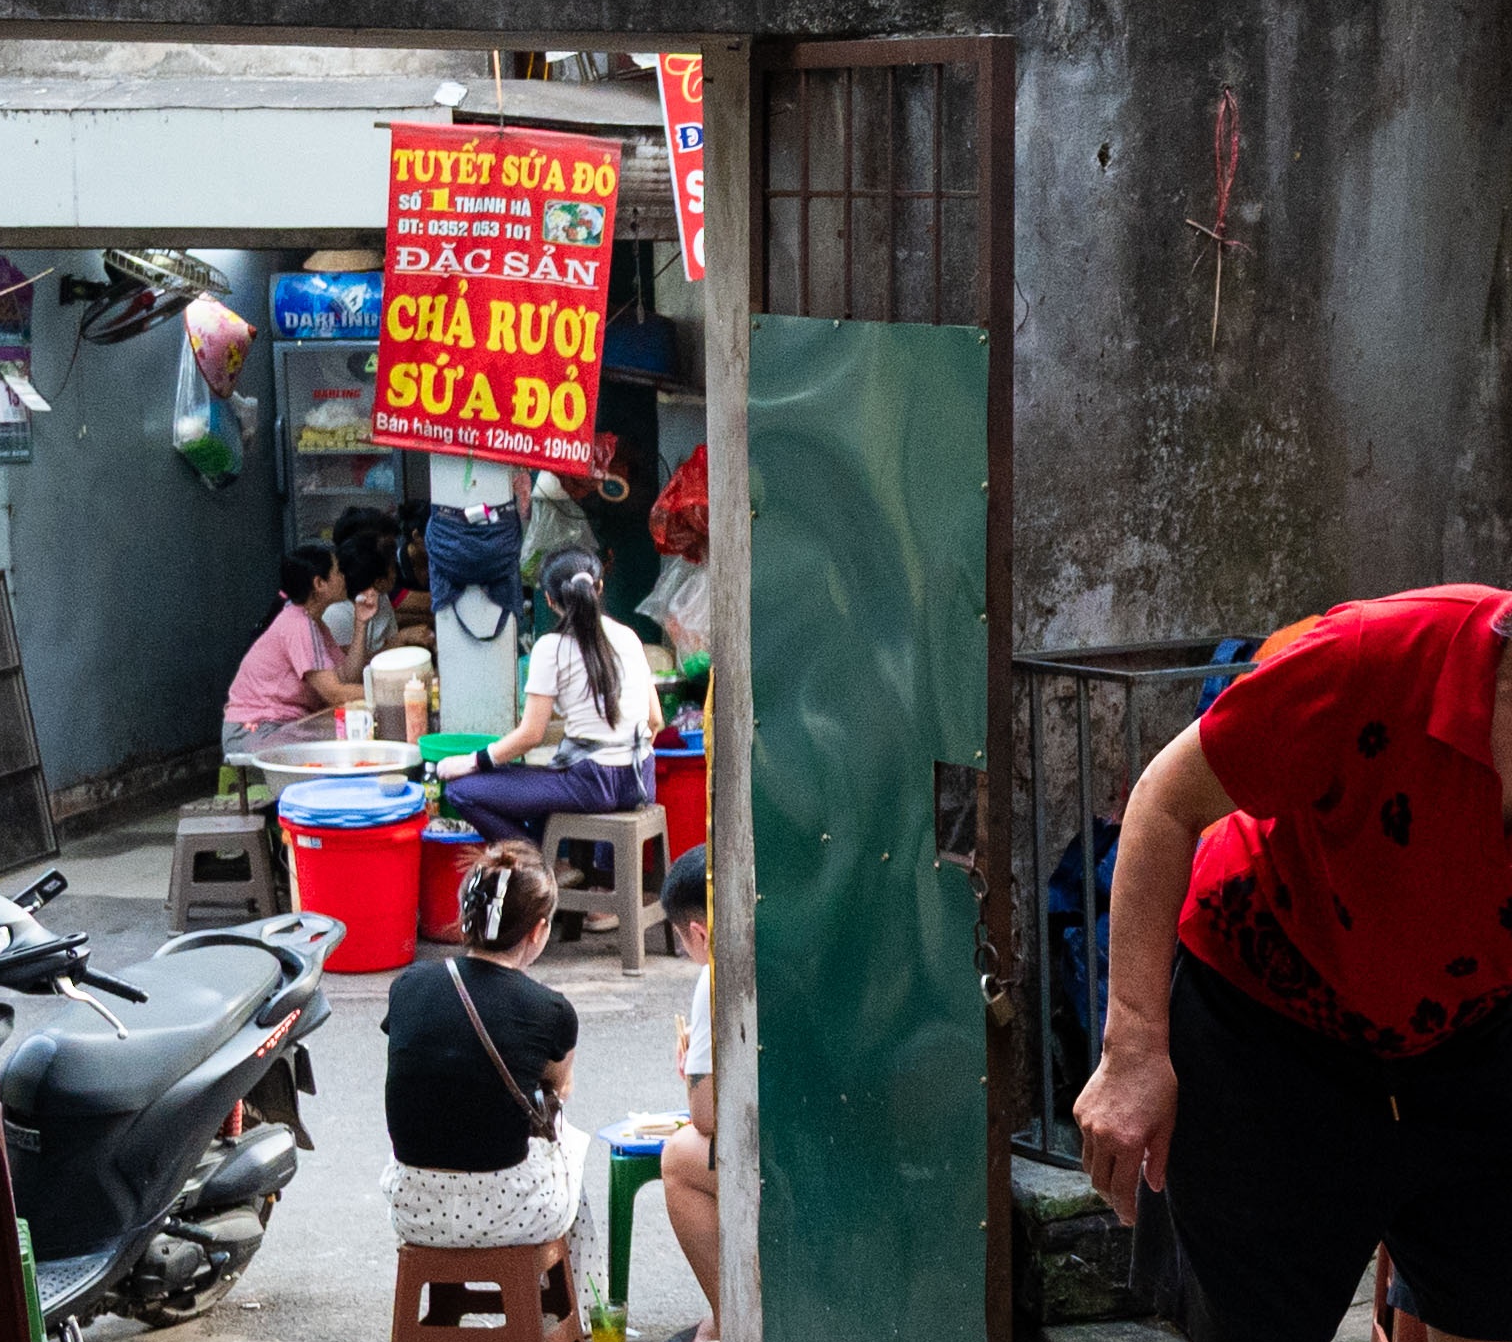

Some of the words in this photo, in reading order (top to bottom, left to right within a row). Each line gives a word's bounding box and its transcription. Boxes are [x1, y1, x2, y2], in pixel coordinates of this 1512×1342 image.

[393, 138, 496, 185] TUYẾT
[501, 148, 567, 194] SỨA
[571, 153, 617, 197] ĐỎ
[398, 189, 423, 211] SỐ
[426, 187, 455, 212] 1
[454, 196, 507, 215] THANH
[510, 197, 532, 217] HÀ
[428, 220, 468, 237] 0352
[472, 221, 500, 238] 053
[505, 222, 531, 241] 101
[394, 241, 492, 278] ĐẶC
[502, 244, 600, 286] SẢN
[386, 279, 476, 349] CHẢ
[486, 299, 600, 363] RƯƠI
[386, 352, 501, 422] SỨA
[511, 364, 587, 433] ĐỎ
[376, 412, 408, 433] Bán
[412, 416, 454, 444] hàng
